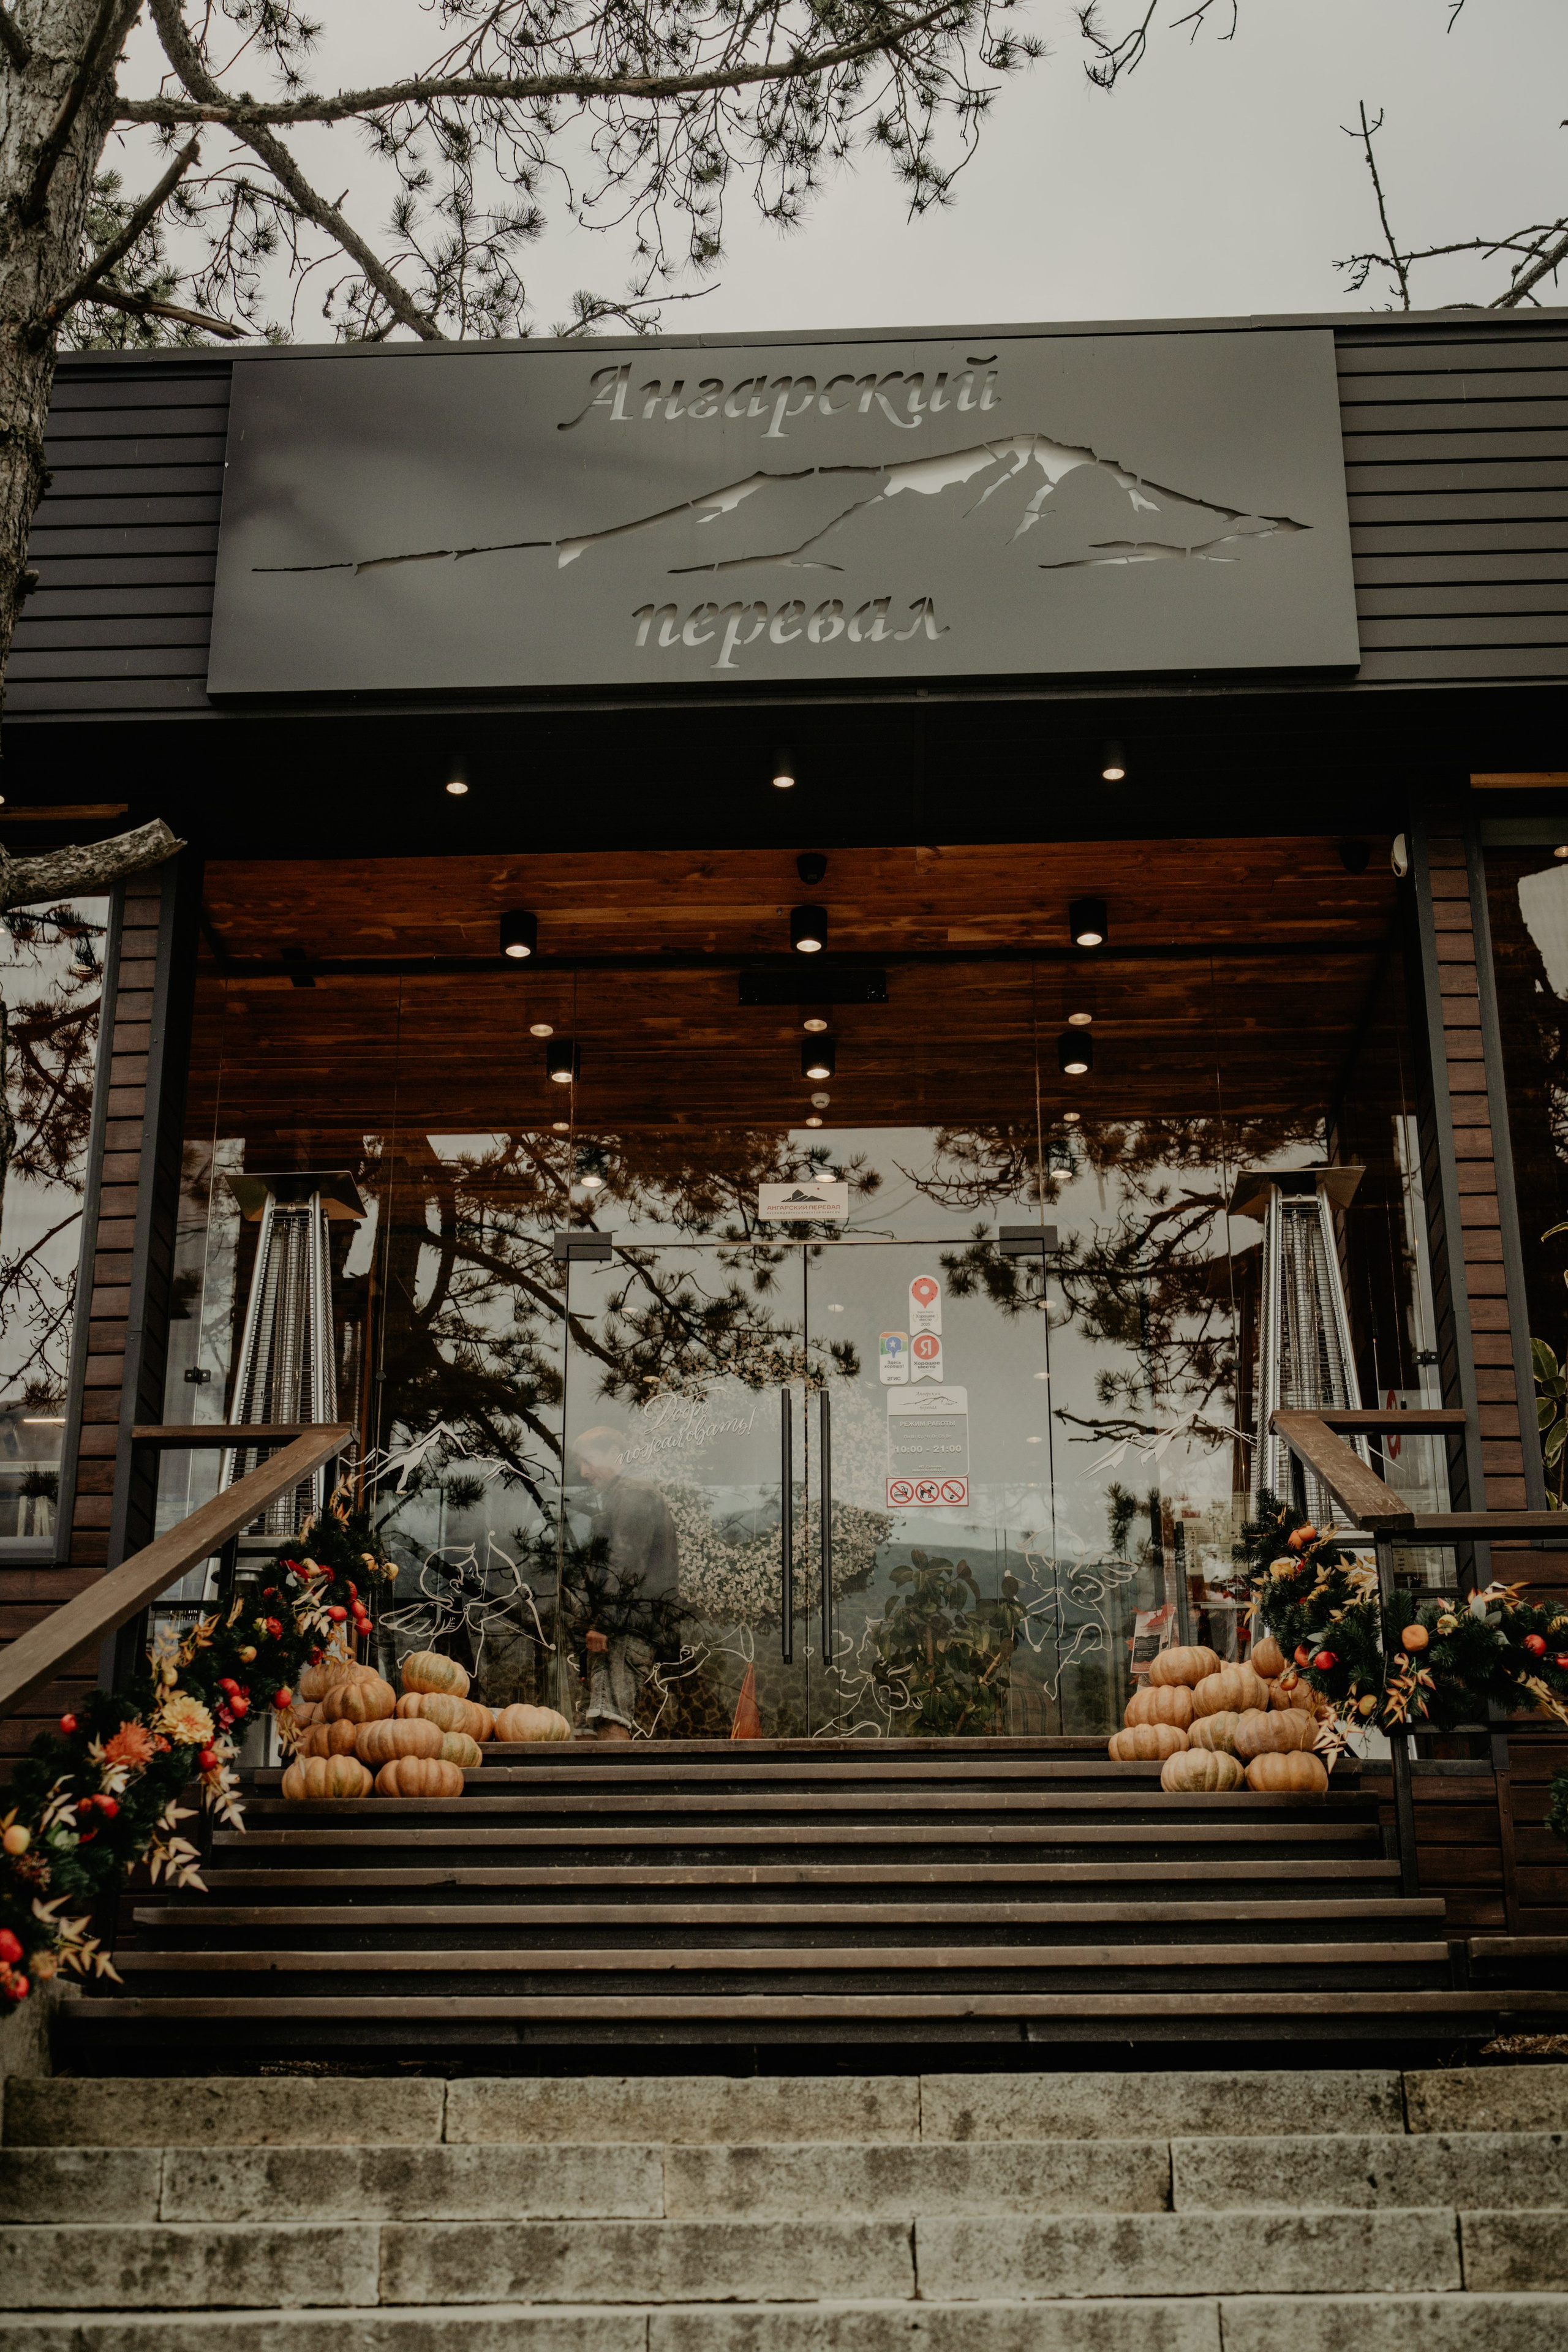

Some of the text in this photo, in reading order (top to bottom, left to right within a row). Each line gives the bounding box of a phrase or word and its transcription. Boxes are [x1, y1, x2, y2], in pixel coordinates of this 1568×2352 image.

[557, 353, 1001, 438] Ангарский
[631, 595, 951, 669] перевал
[615, 1406, 758, 1465] пожаловать!
[644, 1386, 727, 1434] Добро
